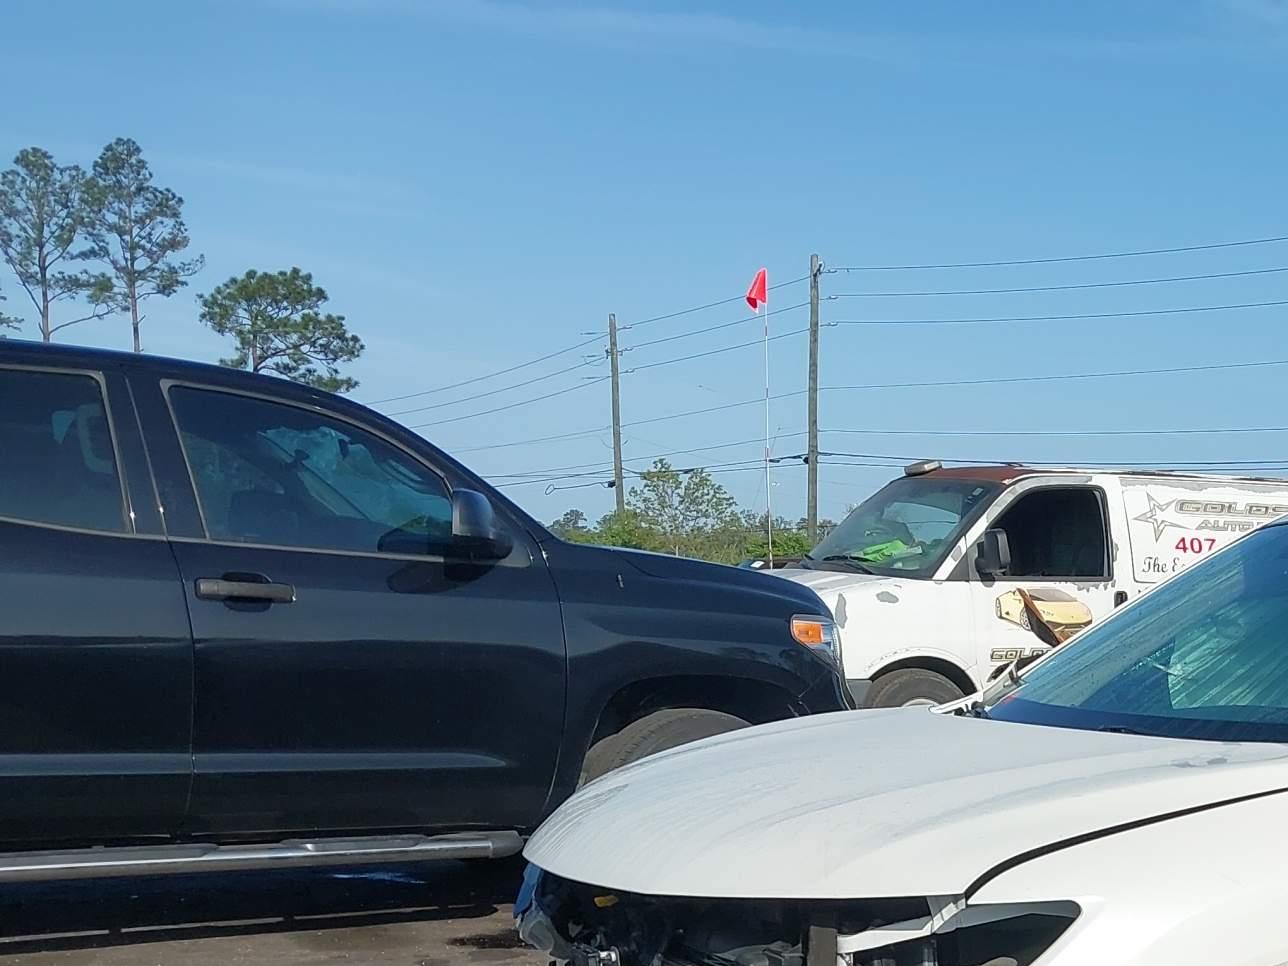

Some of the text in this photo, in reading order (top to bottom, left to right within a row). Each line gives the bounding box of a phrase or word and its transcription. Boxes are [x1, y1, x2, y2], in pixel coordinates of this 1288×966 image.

[1195, 519, 1255, 532] AUTO
[1175, 536, 1217, 554] 407
[1142, 556, 1168, 573] The
